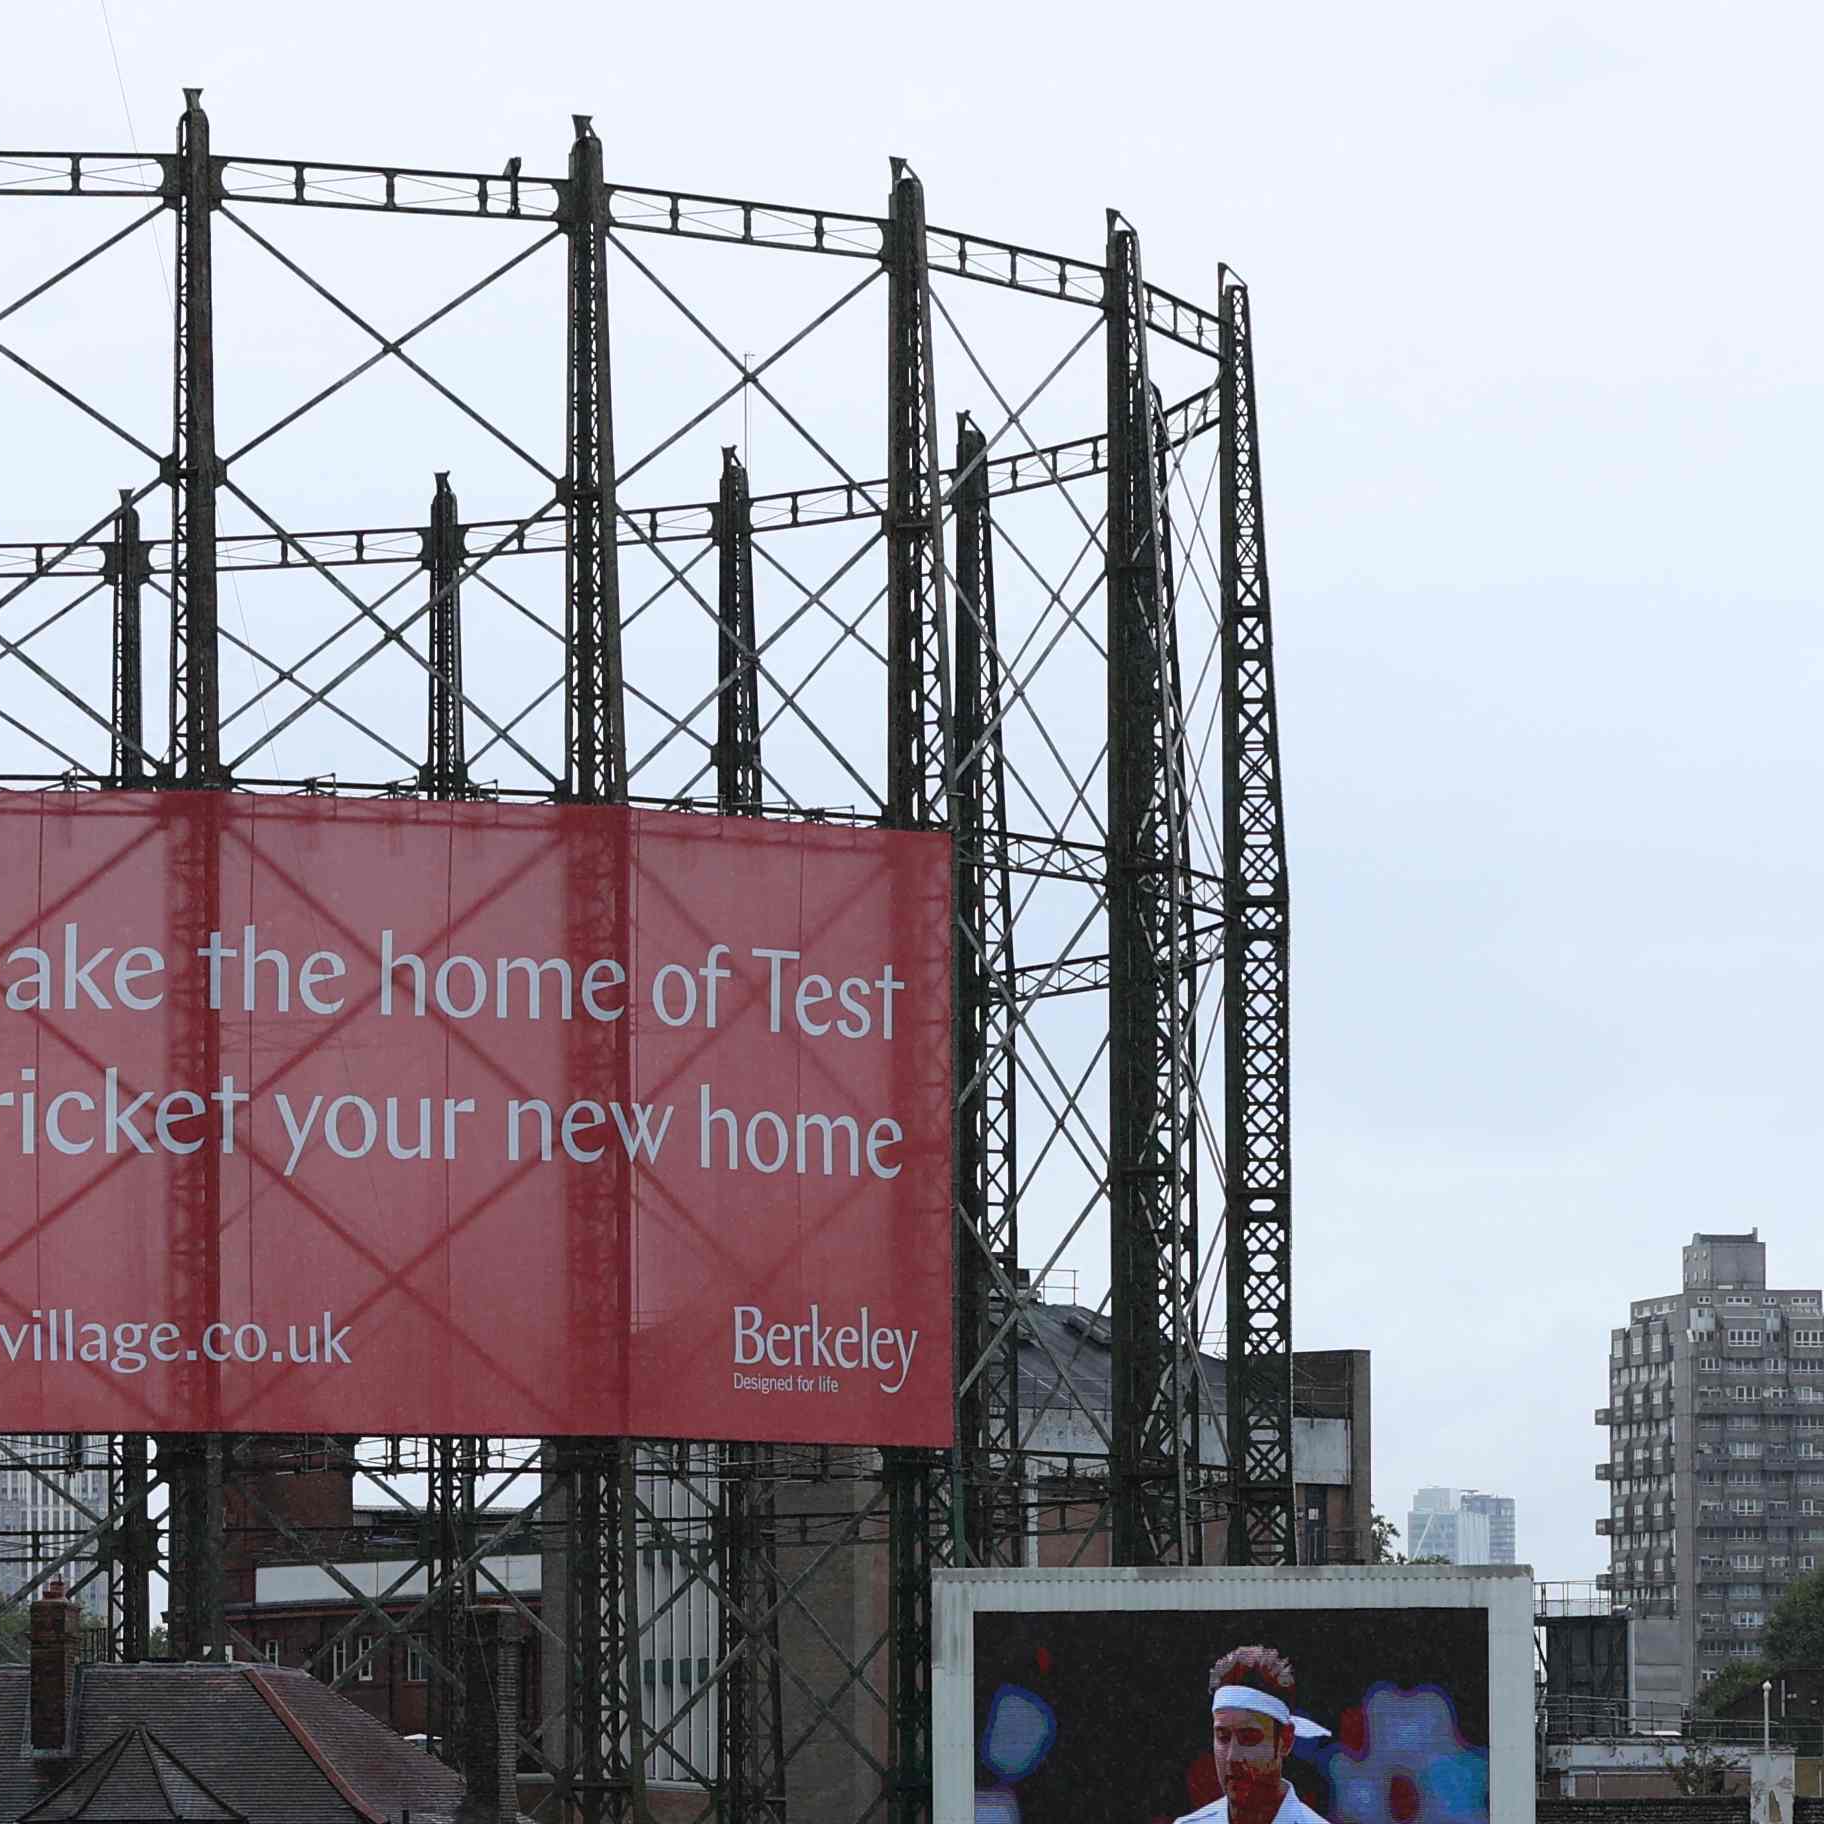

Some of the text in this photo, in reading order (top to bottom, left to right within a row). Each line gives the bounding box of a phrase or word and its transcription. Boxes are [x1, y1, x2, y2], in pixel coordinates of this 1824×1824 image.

[199, 924, 347, 1016] the
[380, 929, 626, 1022] home
[652, 944, 732, 1029] of
[751, 948, 906, 1041] Test
[275, 1094, 476, 1177] your
[508, 1099, 676, 1165] new
[700, 1083, 904, 1180] home
[734, 1304, 919, 1394] Berkeley
[734, 1372, 839, 1394] Designed for life
